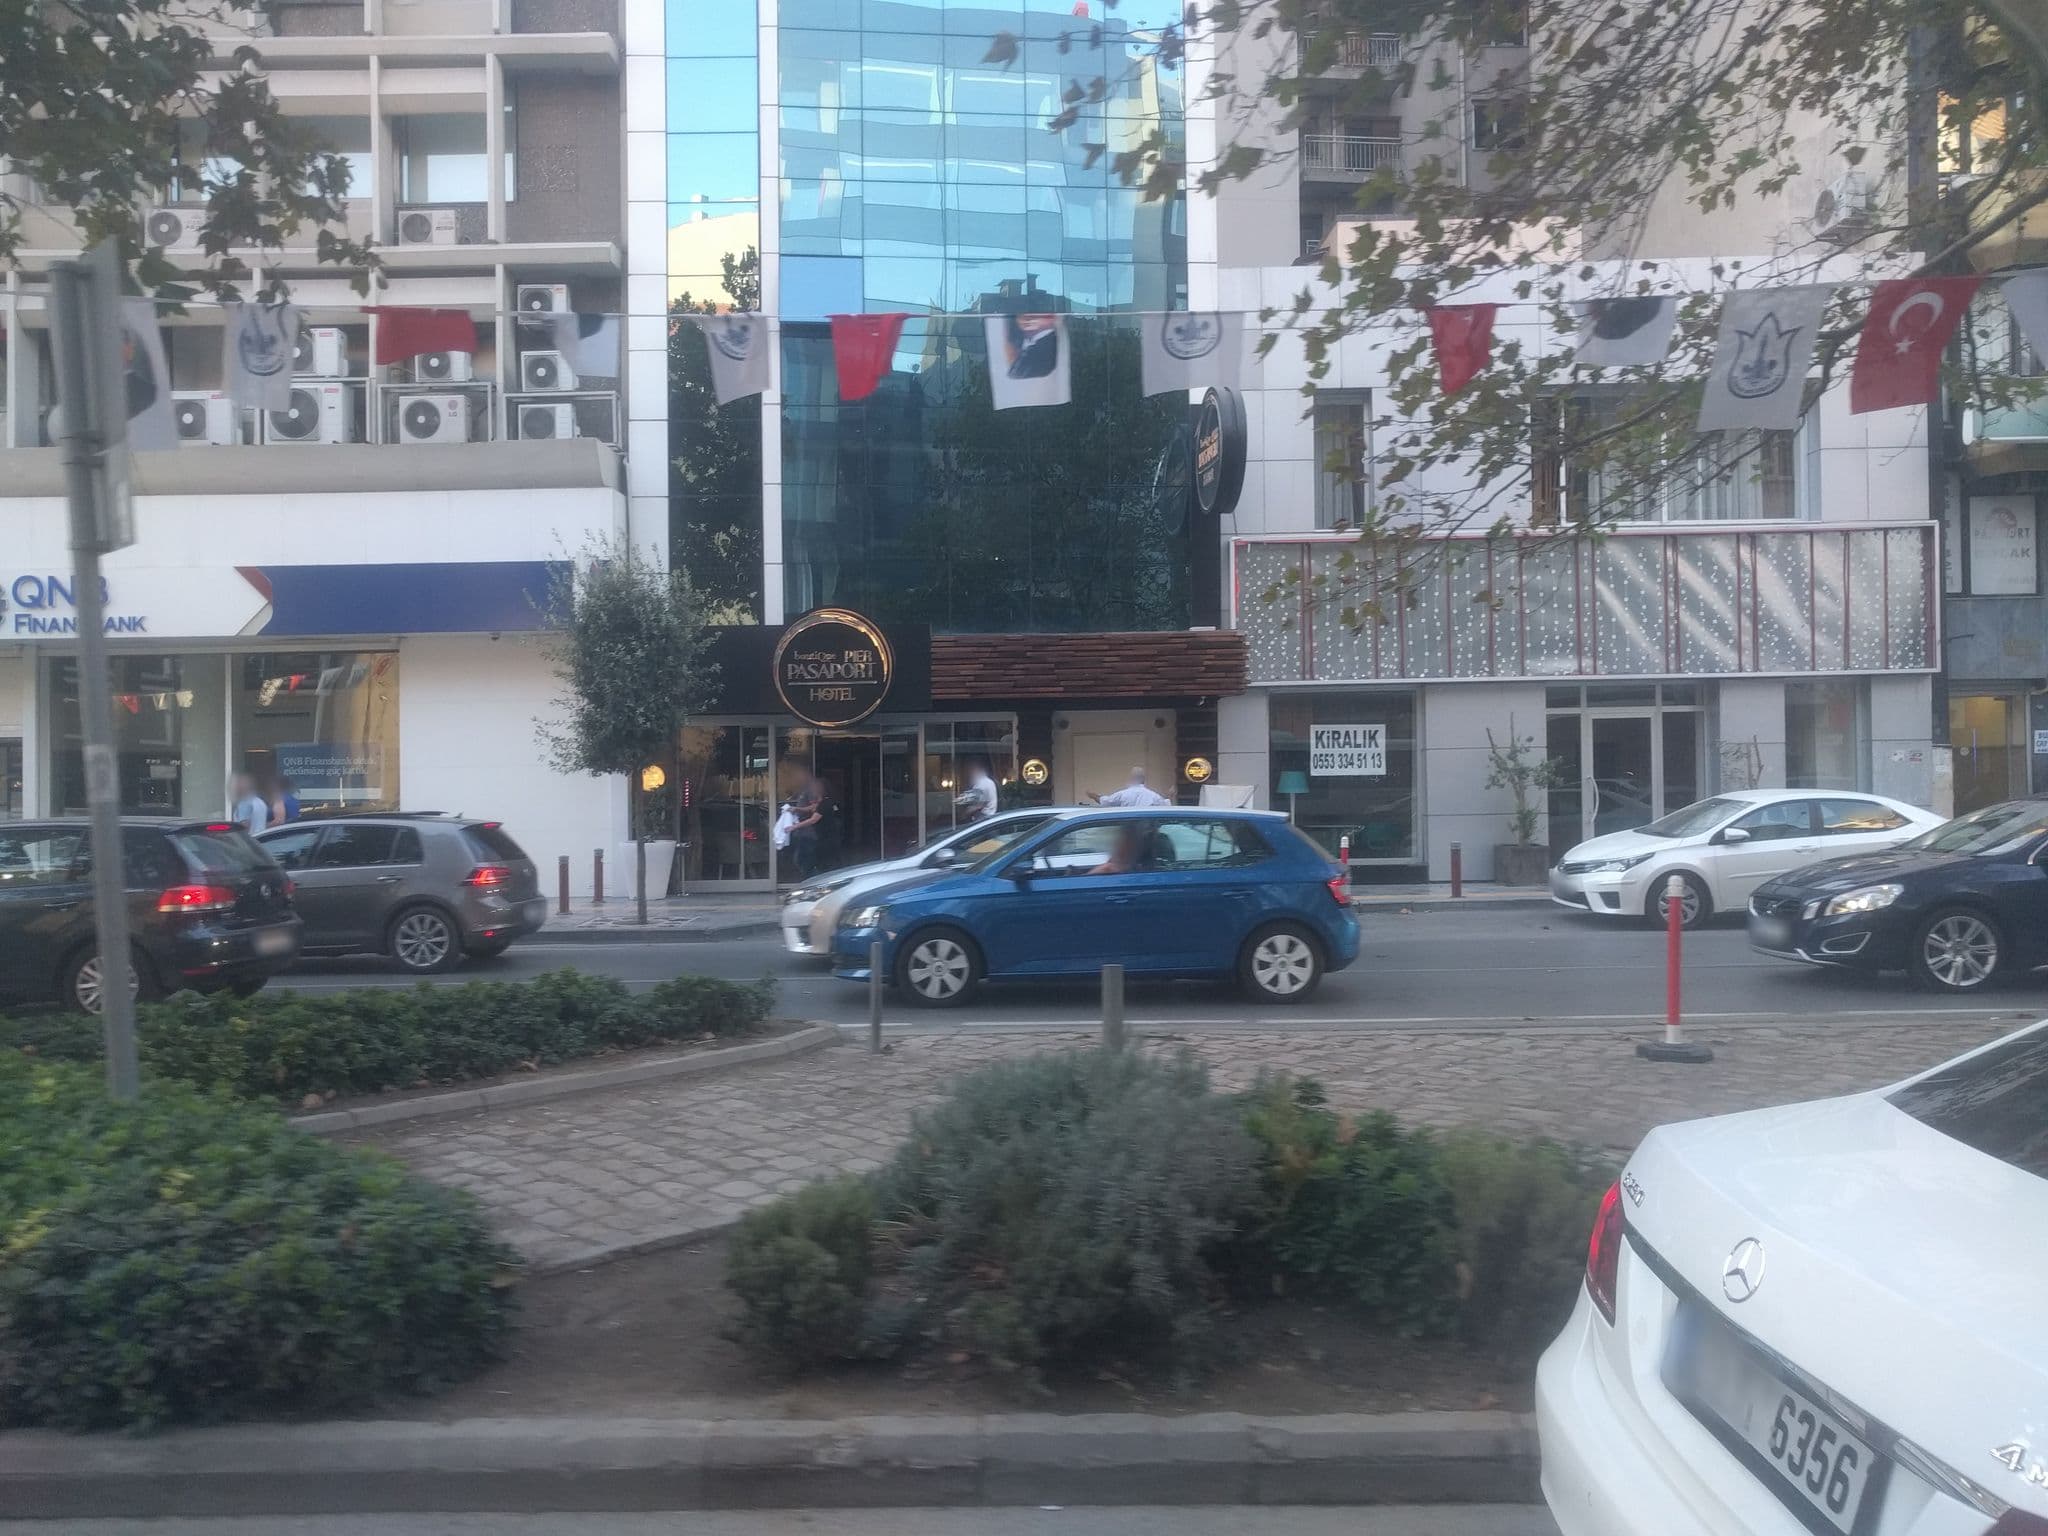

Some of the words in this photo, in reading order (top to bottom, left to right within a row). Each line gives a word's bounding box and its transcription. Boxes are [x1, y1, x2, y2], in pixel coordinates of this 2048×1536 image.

[14, 613, 148, 633] FINANANK
[844, 650, 873, 662] PIER
[787, 662, 877, 679] PASAPORT
[809, 688, 857, 702] HOTEL
[284, 757, 303, 767] QNB
[305, 756, 351, 766] Finansbank
[1312, 753, 1335, 769] 0553
[1337, 753, 1354, 769] 334
[1356, 753, 1368, 769] 51
[1371, 752, 1382, 768] 13
[1767, 1394, 1859, 1514] 6356
